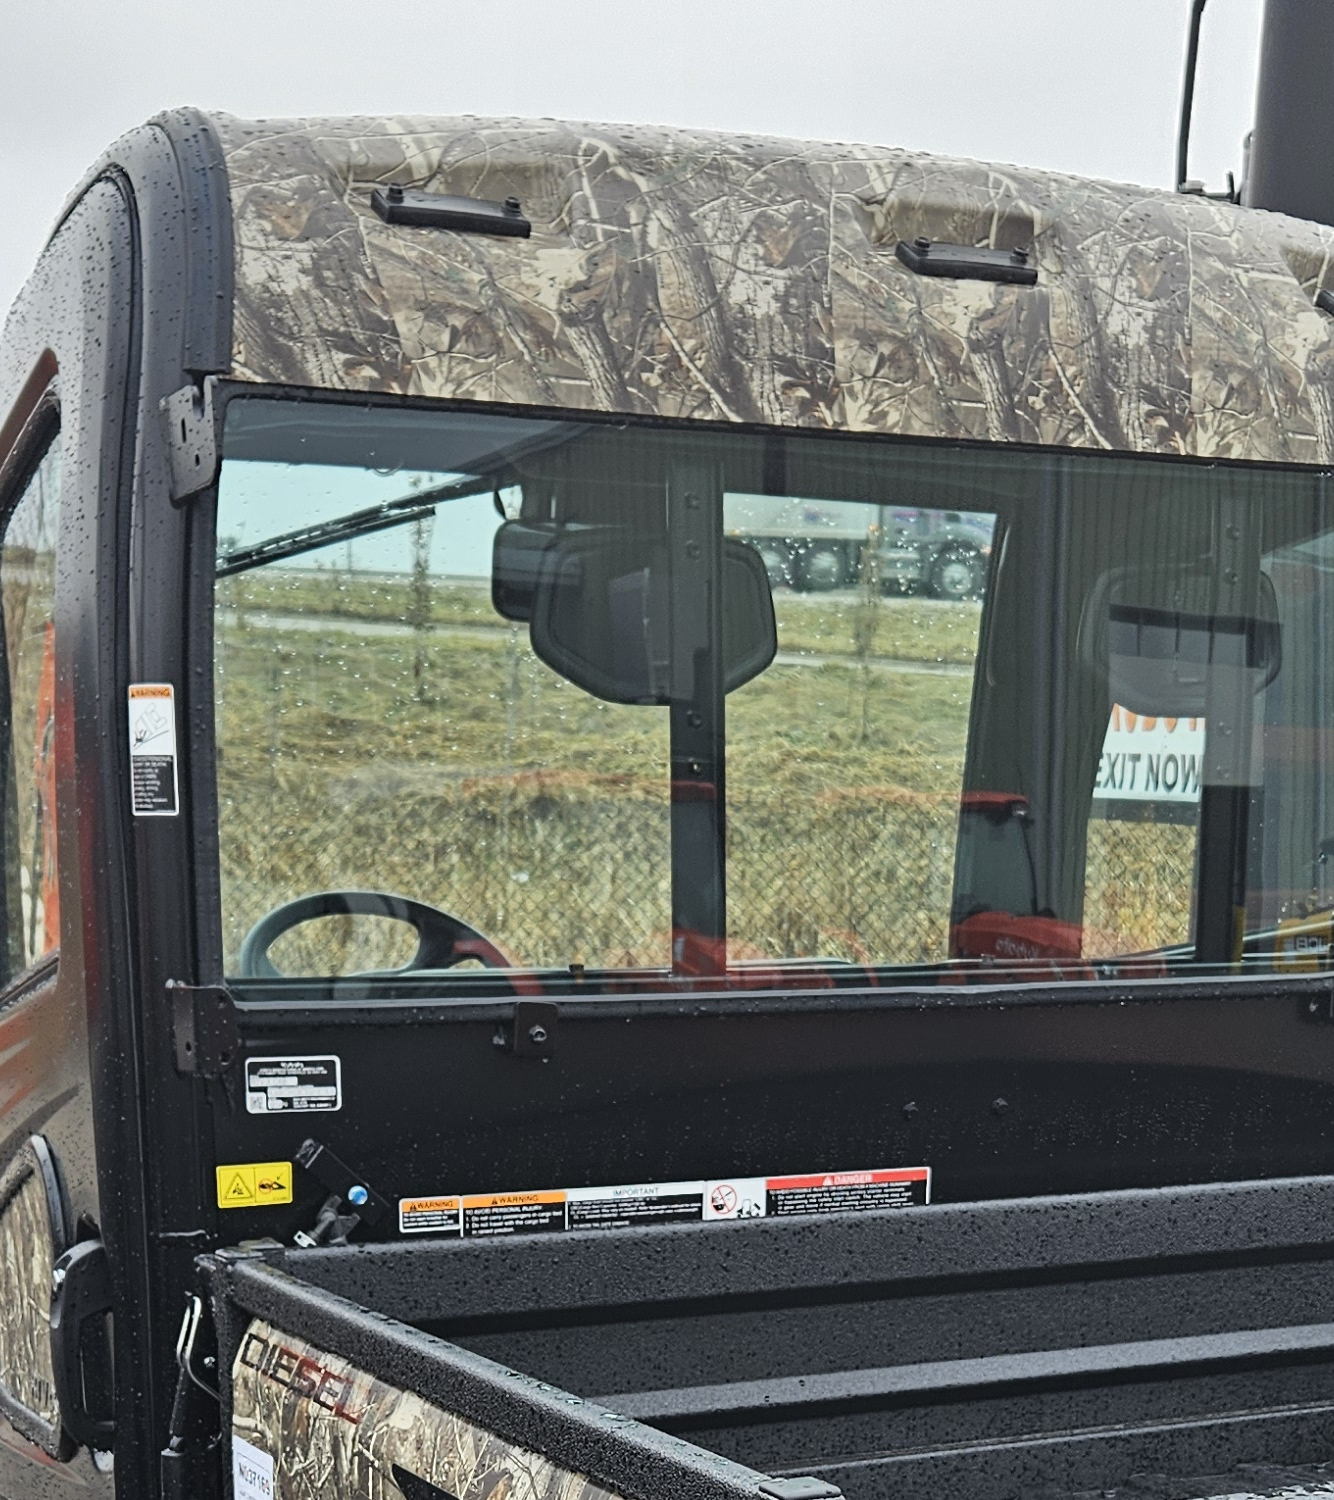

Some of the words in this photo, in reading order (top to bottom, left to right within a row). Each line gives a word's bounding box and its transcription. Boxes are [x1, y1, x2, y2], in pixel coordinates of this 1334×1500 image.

[834, 1174, 873, 1185] DANGER
[613, 1187, 659, 1196] IMPORTANT
[499, 1195, 539, 1204] WARNING
[240, 1333, 361, 1425] DIESEL
